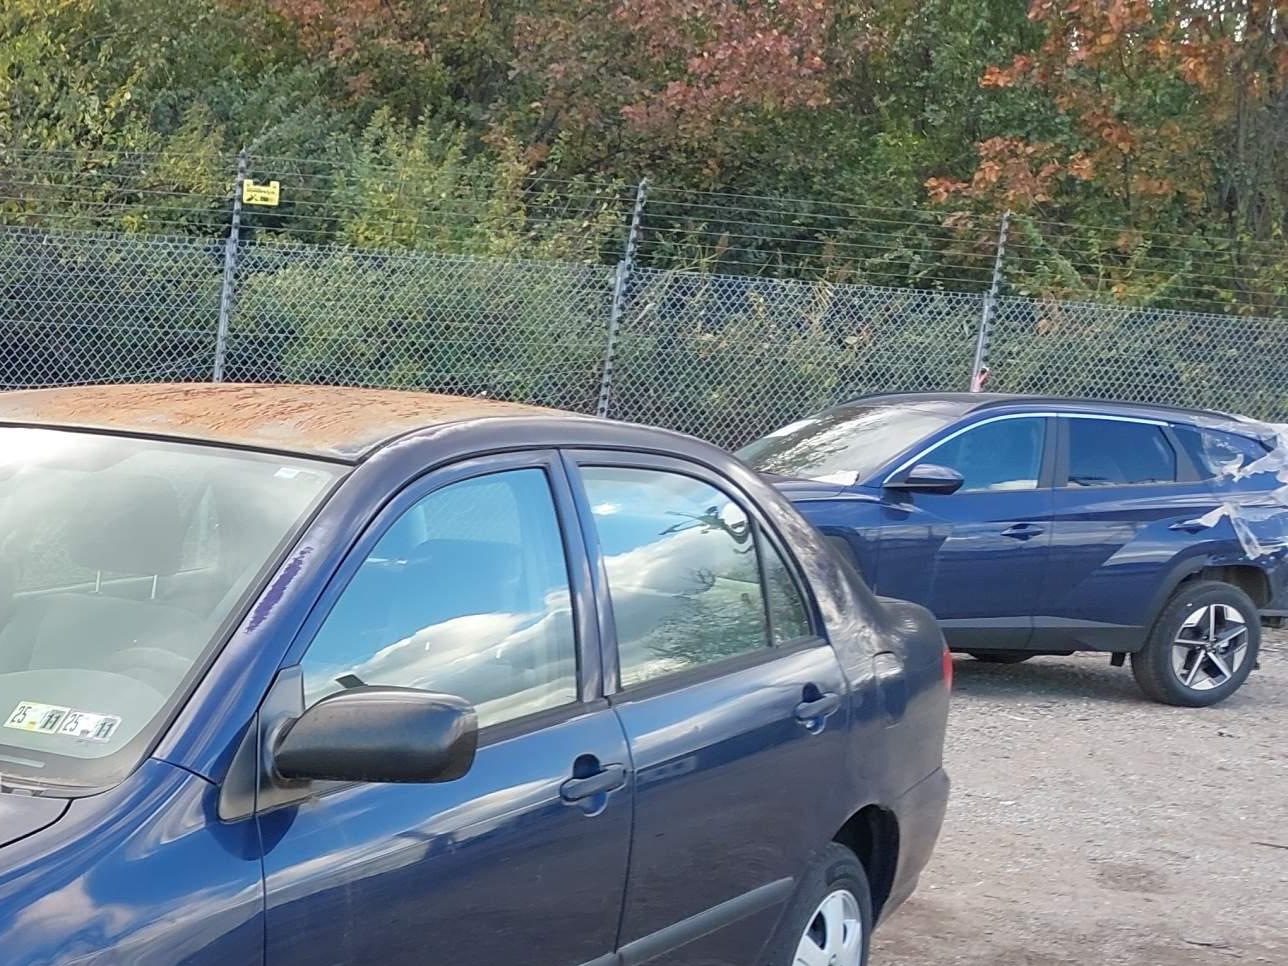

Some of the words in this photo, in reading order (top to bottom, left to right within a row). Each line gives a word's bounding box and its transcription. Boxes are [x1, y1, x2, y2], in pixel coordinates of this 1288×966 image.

[11, 705, 32, 723] 25
[41, 712, 62, 730] 11
[64, 713, 84, 732] 25
[95, 721, 114, 738] 11
